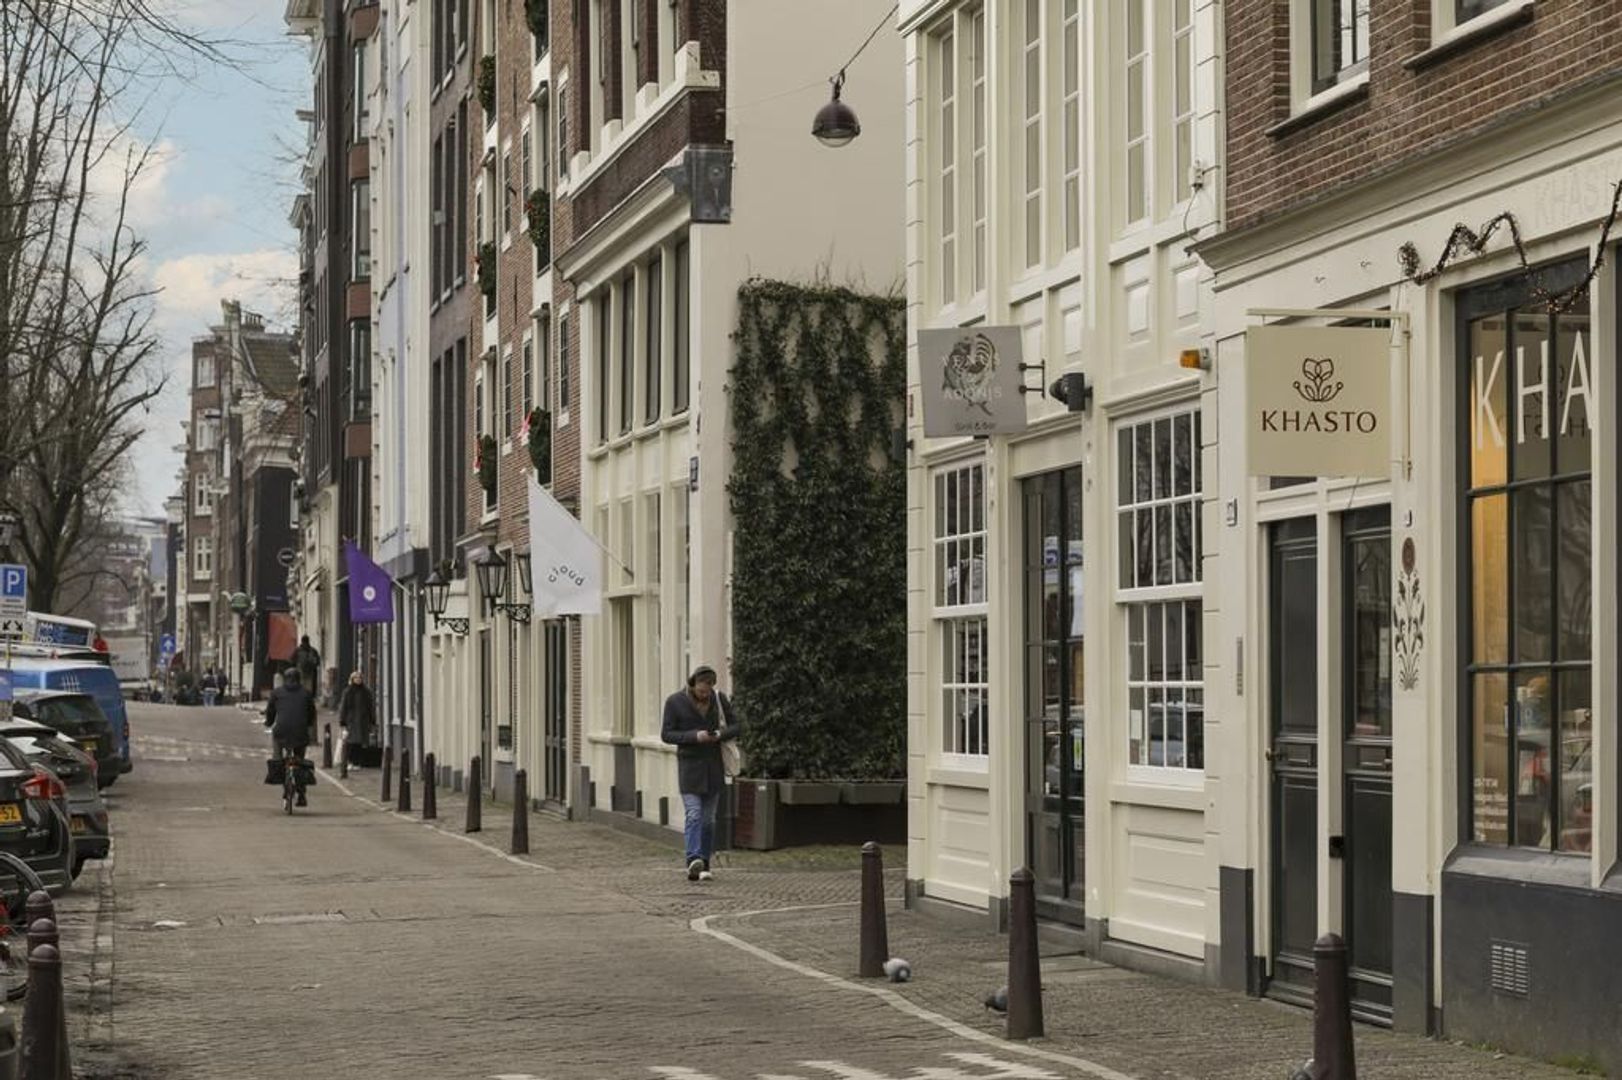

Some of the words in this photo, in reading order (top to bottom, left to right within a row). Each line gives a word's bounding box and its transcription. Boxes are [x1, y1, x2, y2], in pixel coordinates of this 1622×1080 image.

[1262, 409, 1377, 434] KHASTO
[7, 570, 21, 594] P
[548, 565, 586, 587] cloud
